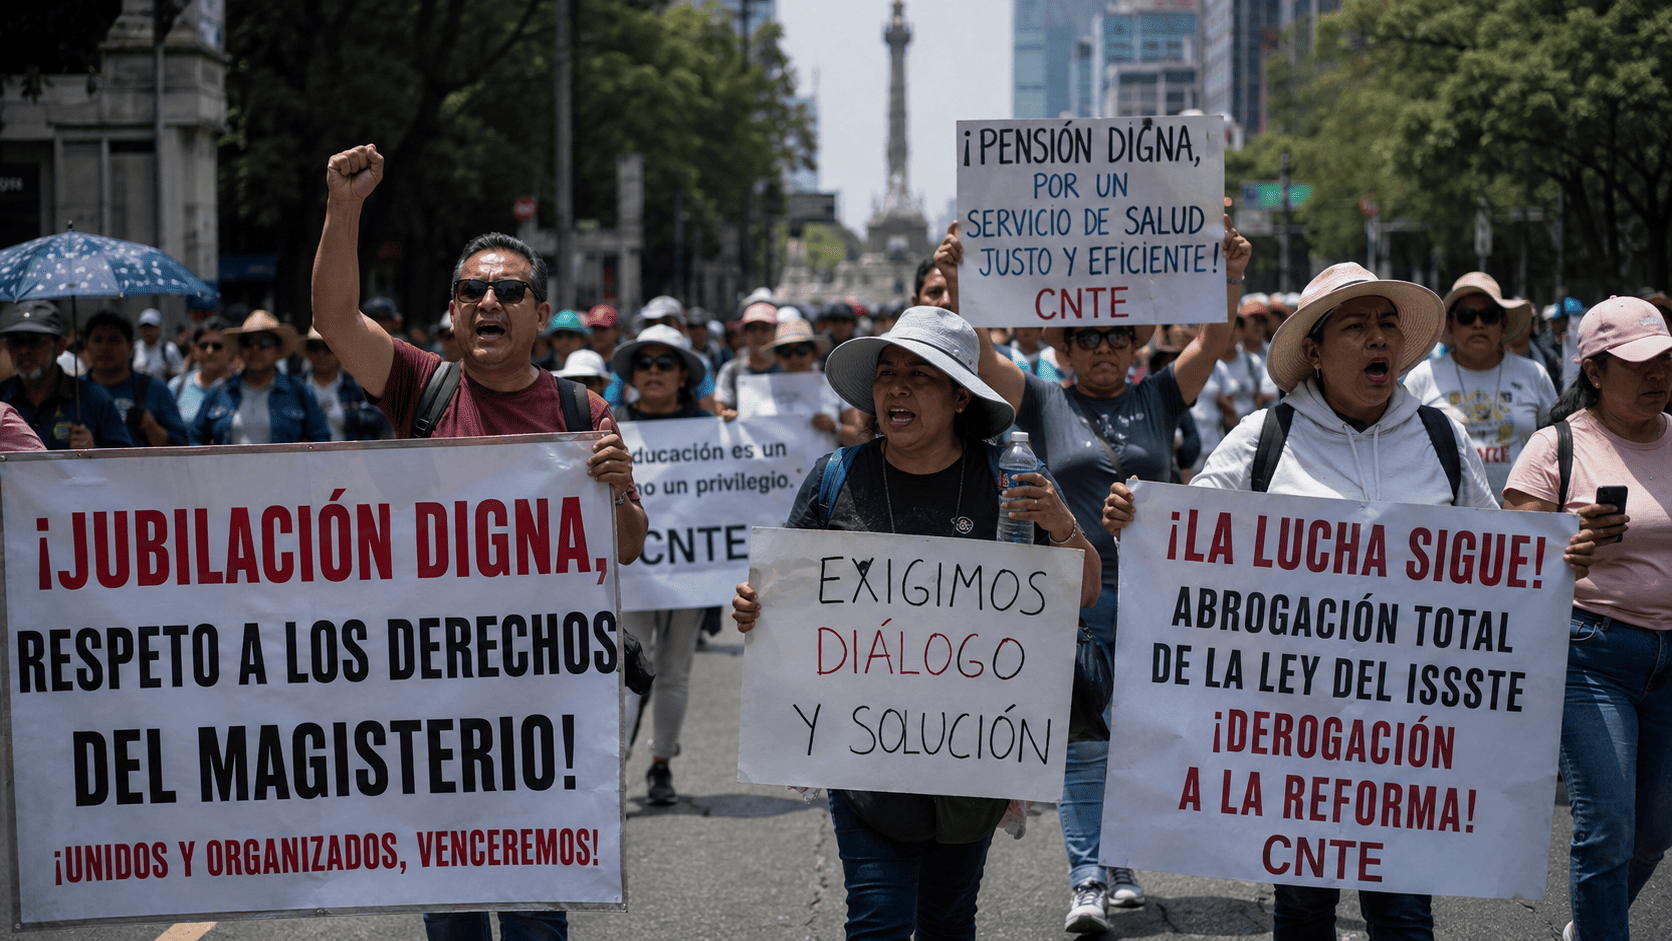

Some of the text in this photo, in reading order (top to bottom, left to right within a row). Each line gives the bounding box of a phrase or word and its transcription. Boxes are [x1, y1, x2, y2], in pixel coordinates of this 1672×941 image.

[964, 121, 1200, 167] ¡PENSIÓN DIGNA,
[1034, 173, 1127, 199] POR UN
[966, 205, 1204, 237] SERVICIO DE SALUD
[979, 242, 1219, 276] JUSTO Y EFICIENTE!
[1036, 287, 1128, 320] CNTE
[632, 443, 787, 464] ducación es un
[664, 481, 687, 494] un
[697, 471, 793, 497] privilegio.
[36, 489, 607, 590] ¡JUBILACIÓN DIGNA,
[639, 524, 748, 565] CNTE
[1167, 509, 1545, 589] ¡LA LUCHA SIGUE!
[819, 557, 1046, 615] EXIGIMOS
[1172, 586, 1512, 653] ABROGACIÓN TOTAL
[18, 611, 618, 693] RESPETO A LOS DERECHOS
[817, 618, 1025, 680] DIÁLOGO
[1152, 643, 1525, 712] DE LA LEY DEL ISSSTE
[73, 714, 575, 806] DEL MAGISTERIO!
[793, 704, 1051, 764] Y SOLUCIÓN
[1213, 709, 1455, 769] ¡DEROGACIÓN
[1179, 767, 1476, 833] A LA REFORMA!
[55, 828, 598, 885] ¡UNIDOS Y ORGANIZADOS, VENCEREMOS!
[1263, 835, 1383, 882] CNTE
